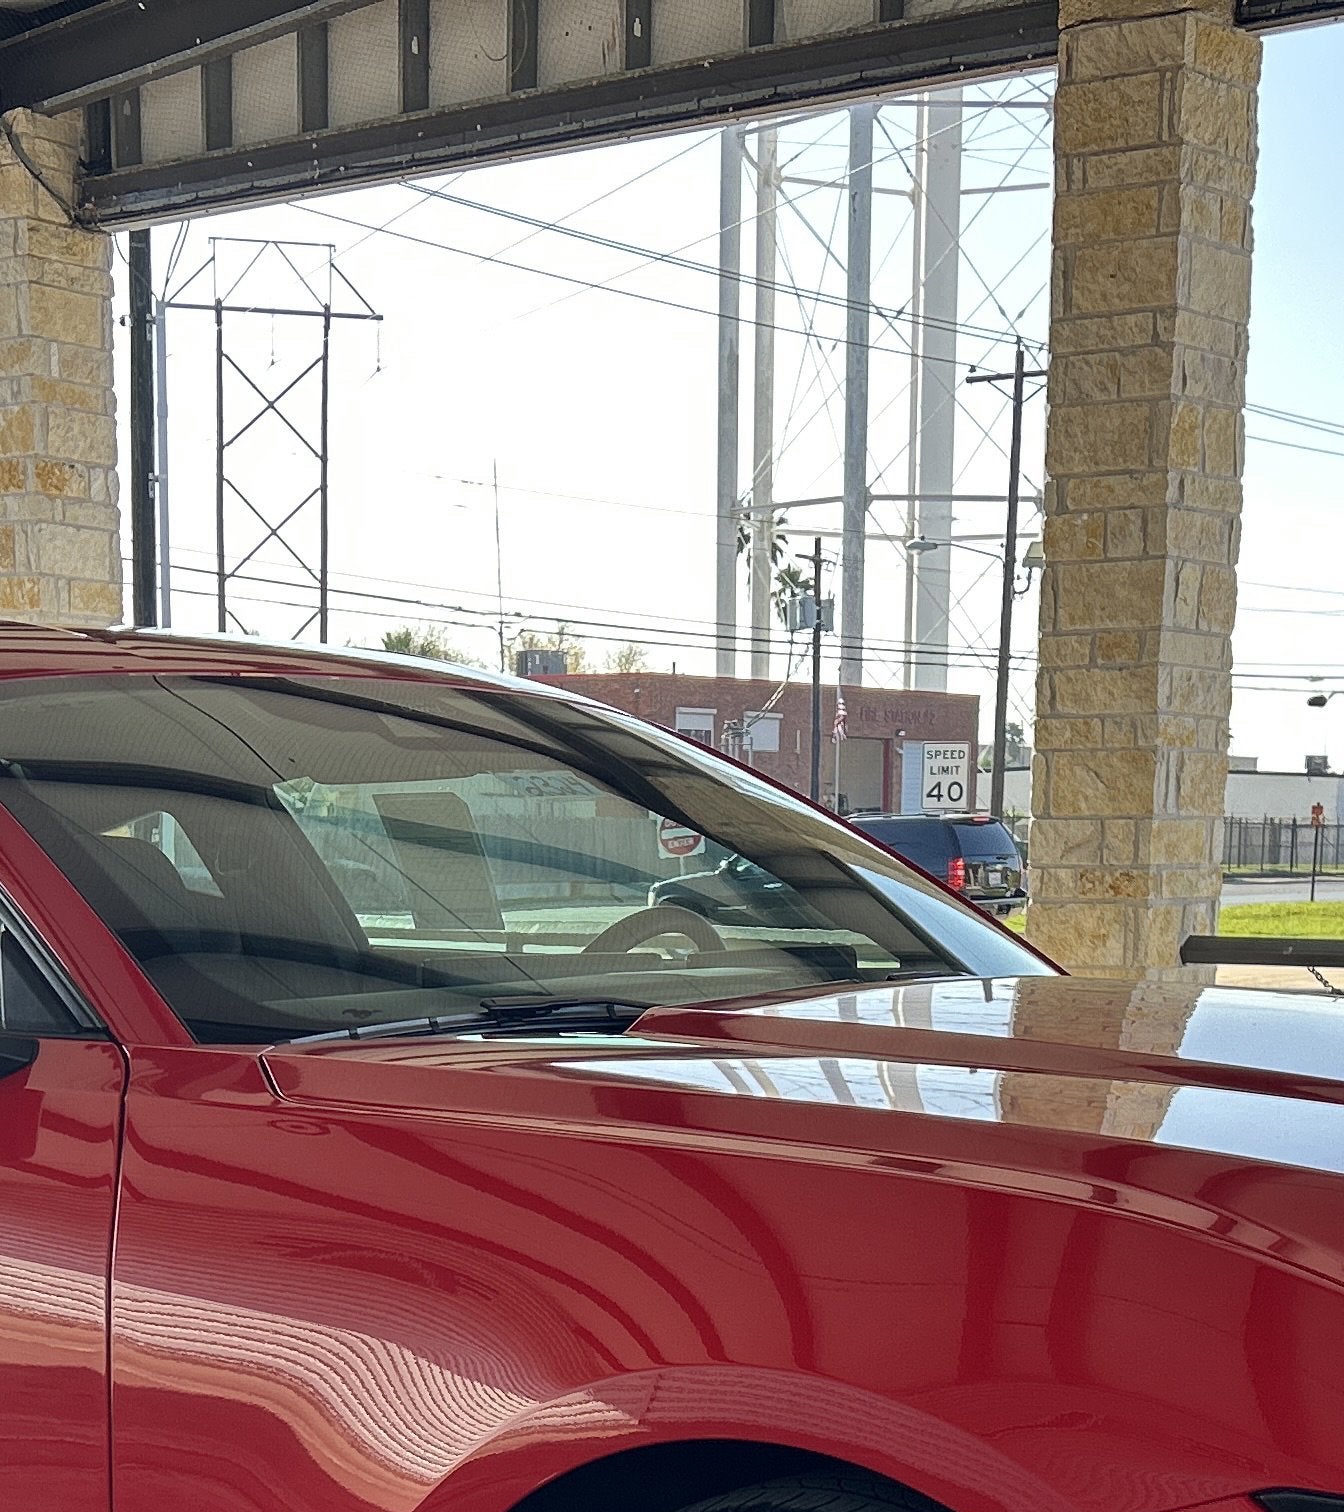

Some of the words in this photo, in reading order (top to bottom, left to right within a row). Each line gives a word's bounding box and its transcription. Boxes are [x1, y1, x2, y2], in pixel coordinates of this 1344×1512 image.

[926, 750, 966, 760] SPEED
[929, 765, 961, 776] LIMIT
[926, 781, 963, 802] 40
